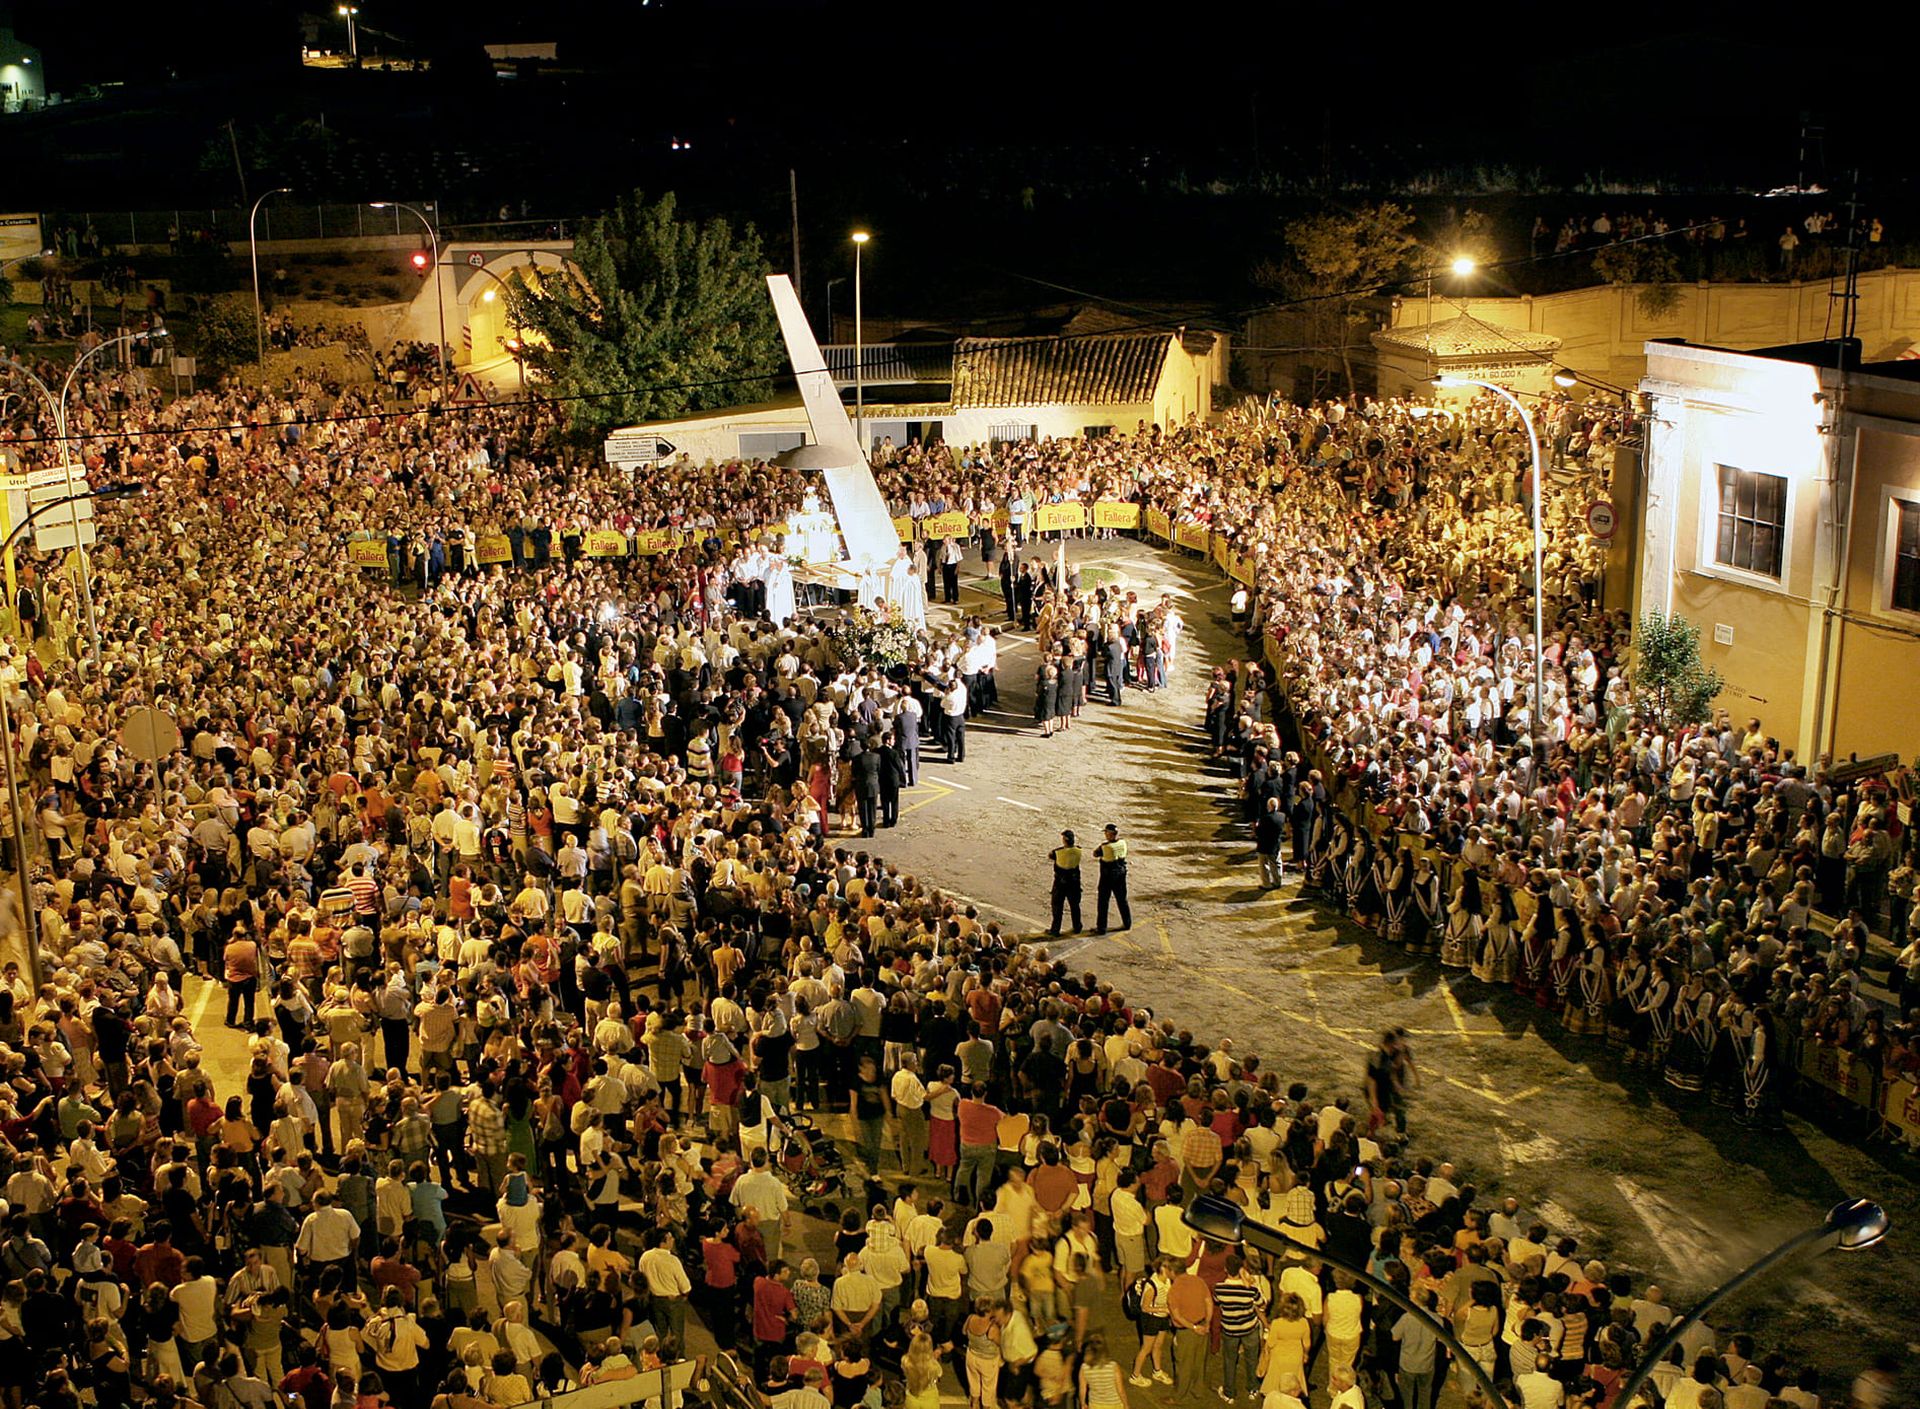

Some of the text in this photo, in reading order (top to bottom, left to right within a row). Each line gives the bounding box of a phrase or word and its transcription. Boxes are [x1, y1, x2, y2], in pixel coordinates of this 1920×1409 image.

[1048, 512, 1076, 524] Fallera
[1103, 510, 1131, 523] Fallera
[933, 521, 963, 534] Fallera
[590, 538, 619, 551] Fallera
[646, 537, 677, 549] Fallera
[355, 548, 385, 562] Fallera
[479, 545, 506, 558] Fallera
